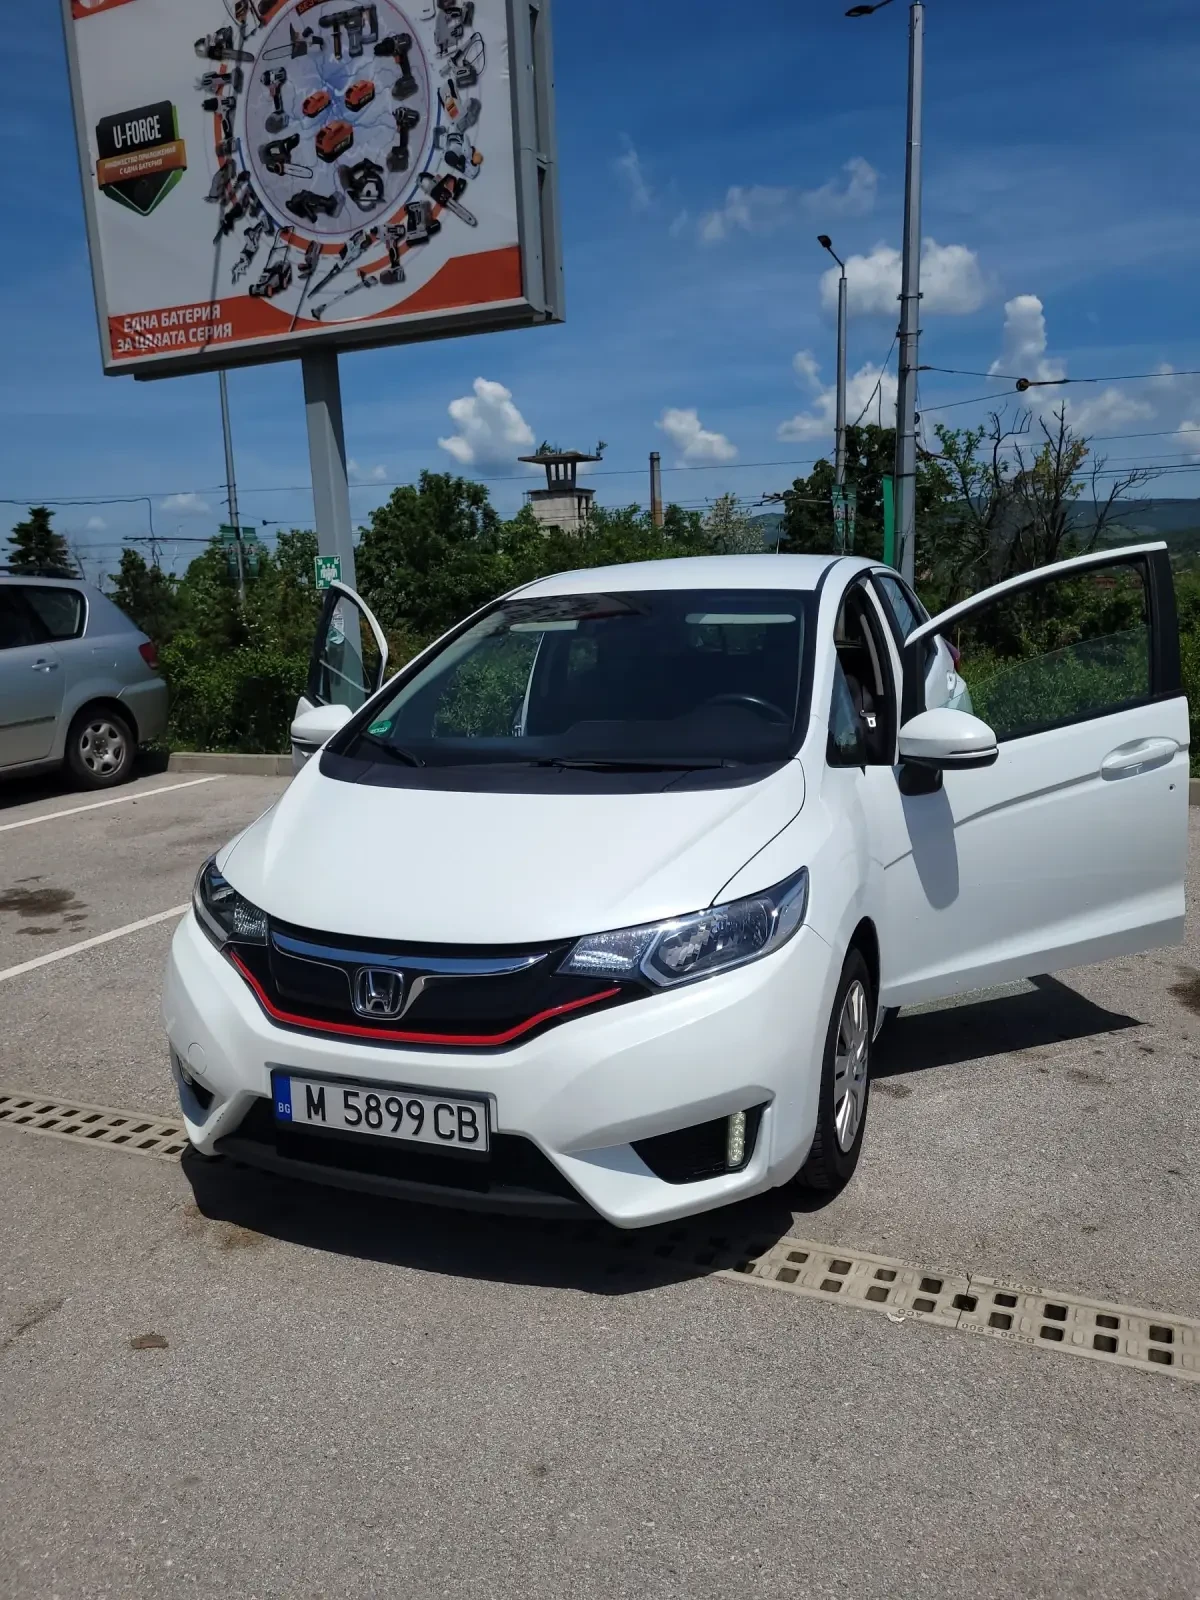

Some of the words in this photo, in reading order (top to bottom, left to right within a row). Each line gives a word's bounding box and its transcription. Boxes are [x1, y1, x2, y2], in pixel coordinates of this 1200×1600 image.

[113, 115, 161, 149] U-FORCE
[124, 314, 159, 335] ЕДНА
[161, 304, 221, 328] БАТЕРИЯ
[117, 337, 133, 353] ЗА
[189, 322, 232, 343] СЕРИЯ
[278, 1102, 291, 1114] BG
